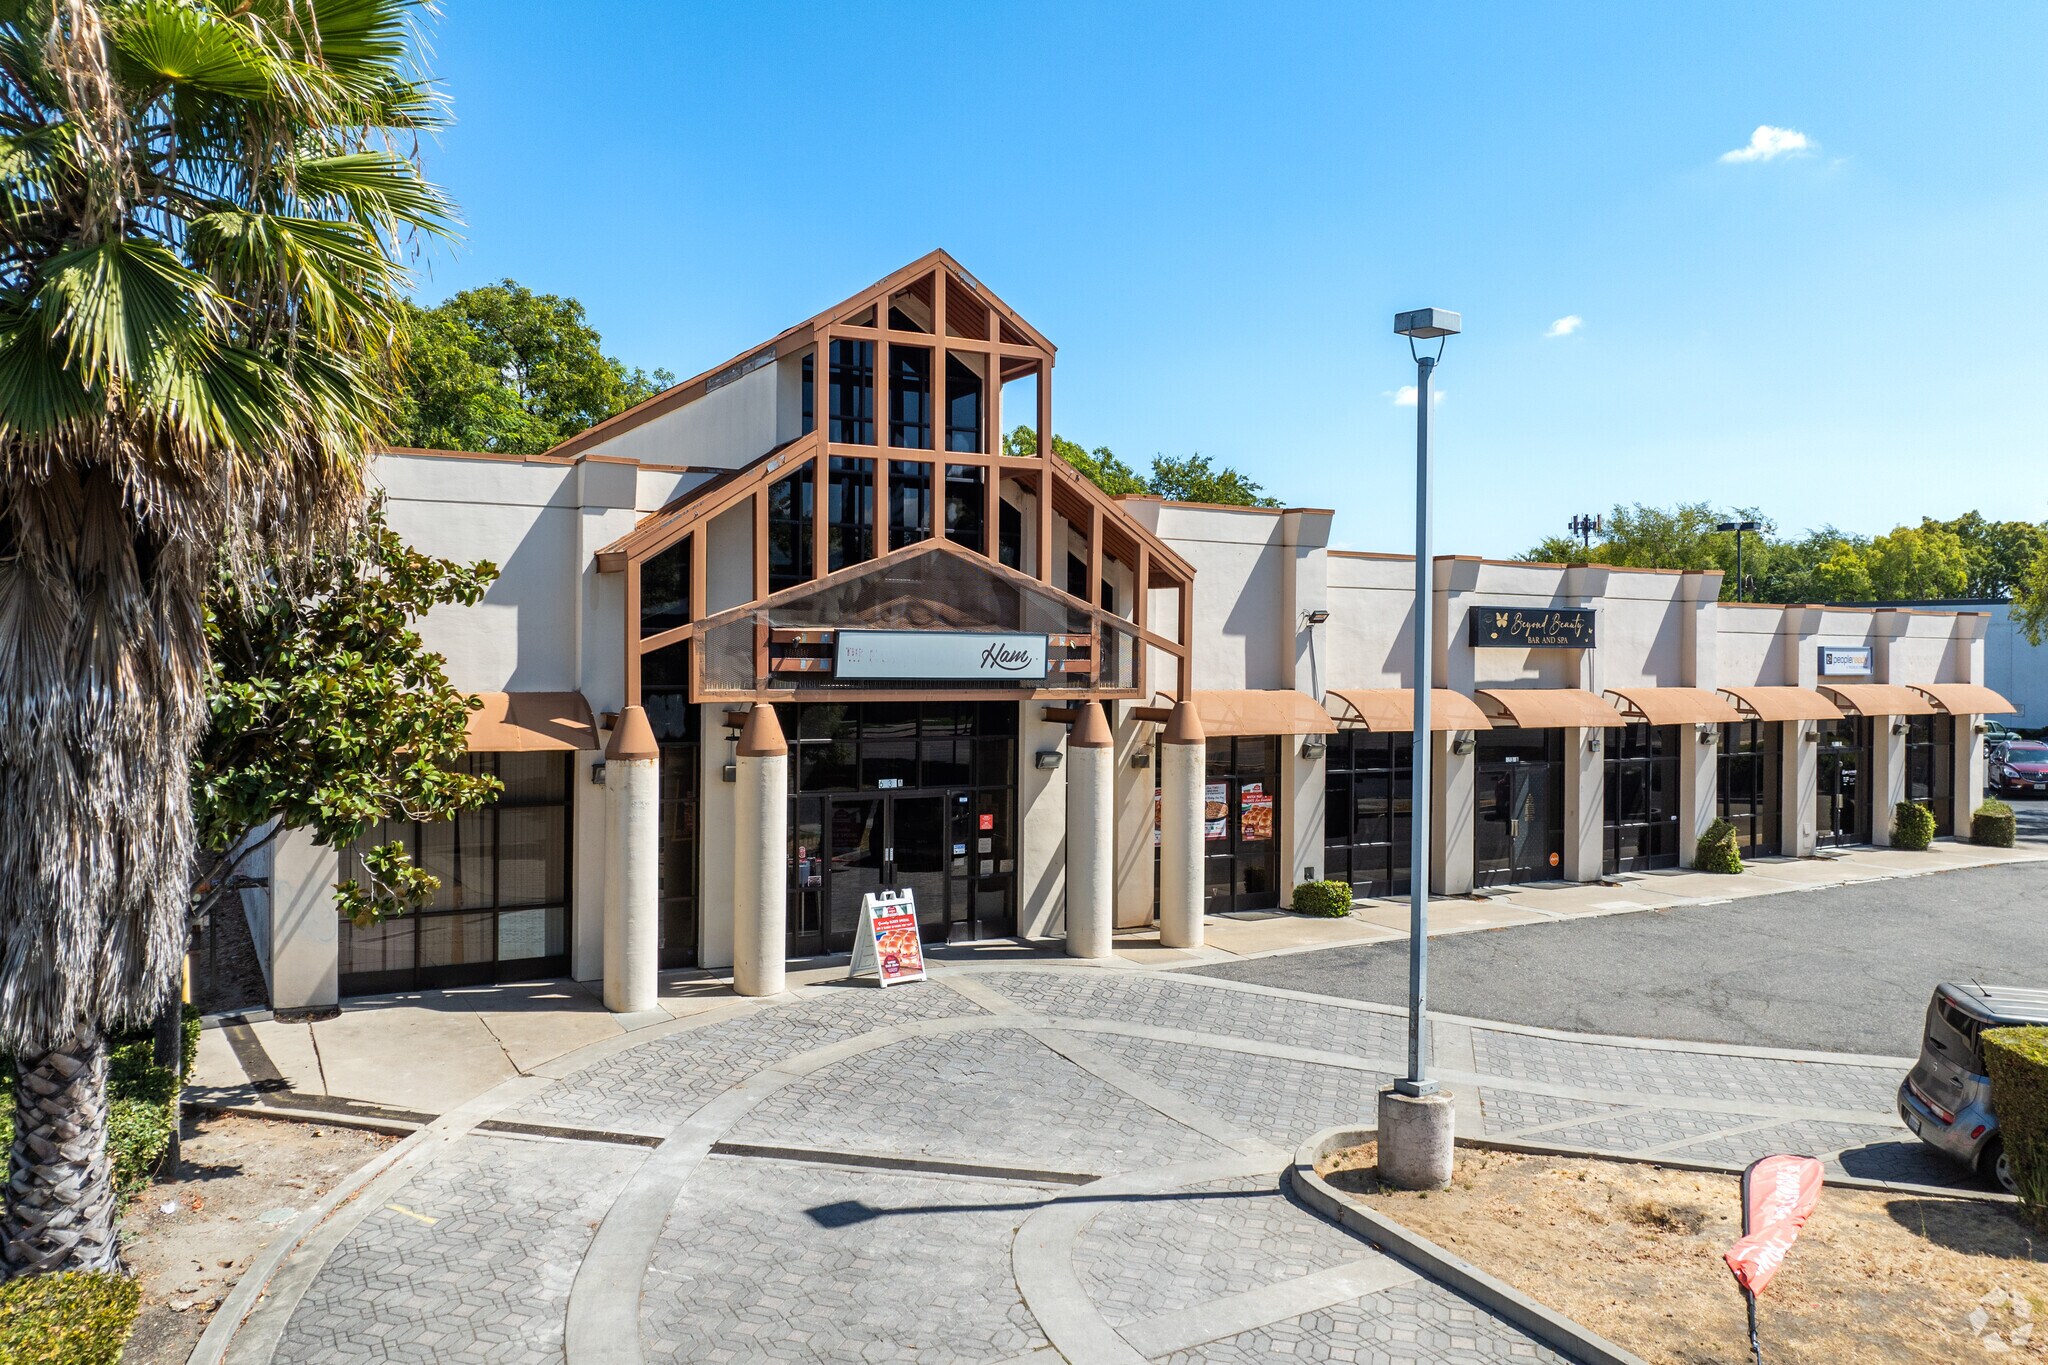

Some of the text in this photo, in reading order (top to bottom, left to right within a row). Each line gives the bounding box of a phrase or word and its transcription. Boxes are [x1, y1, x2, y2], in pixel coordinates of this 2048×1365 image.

[1511, 612, 1585, 638] Beyond Beauty
[1527, 636, 1540, 644] BAR
[1541, 636, 1556, 644] AND
[980, 642, 1032, 670] Ham
